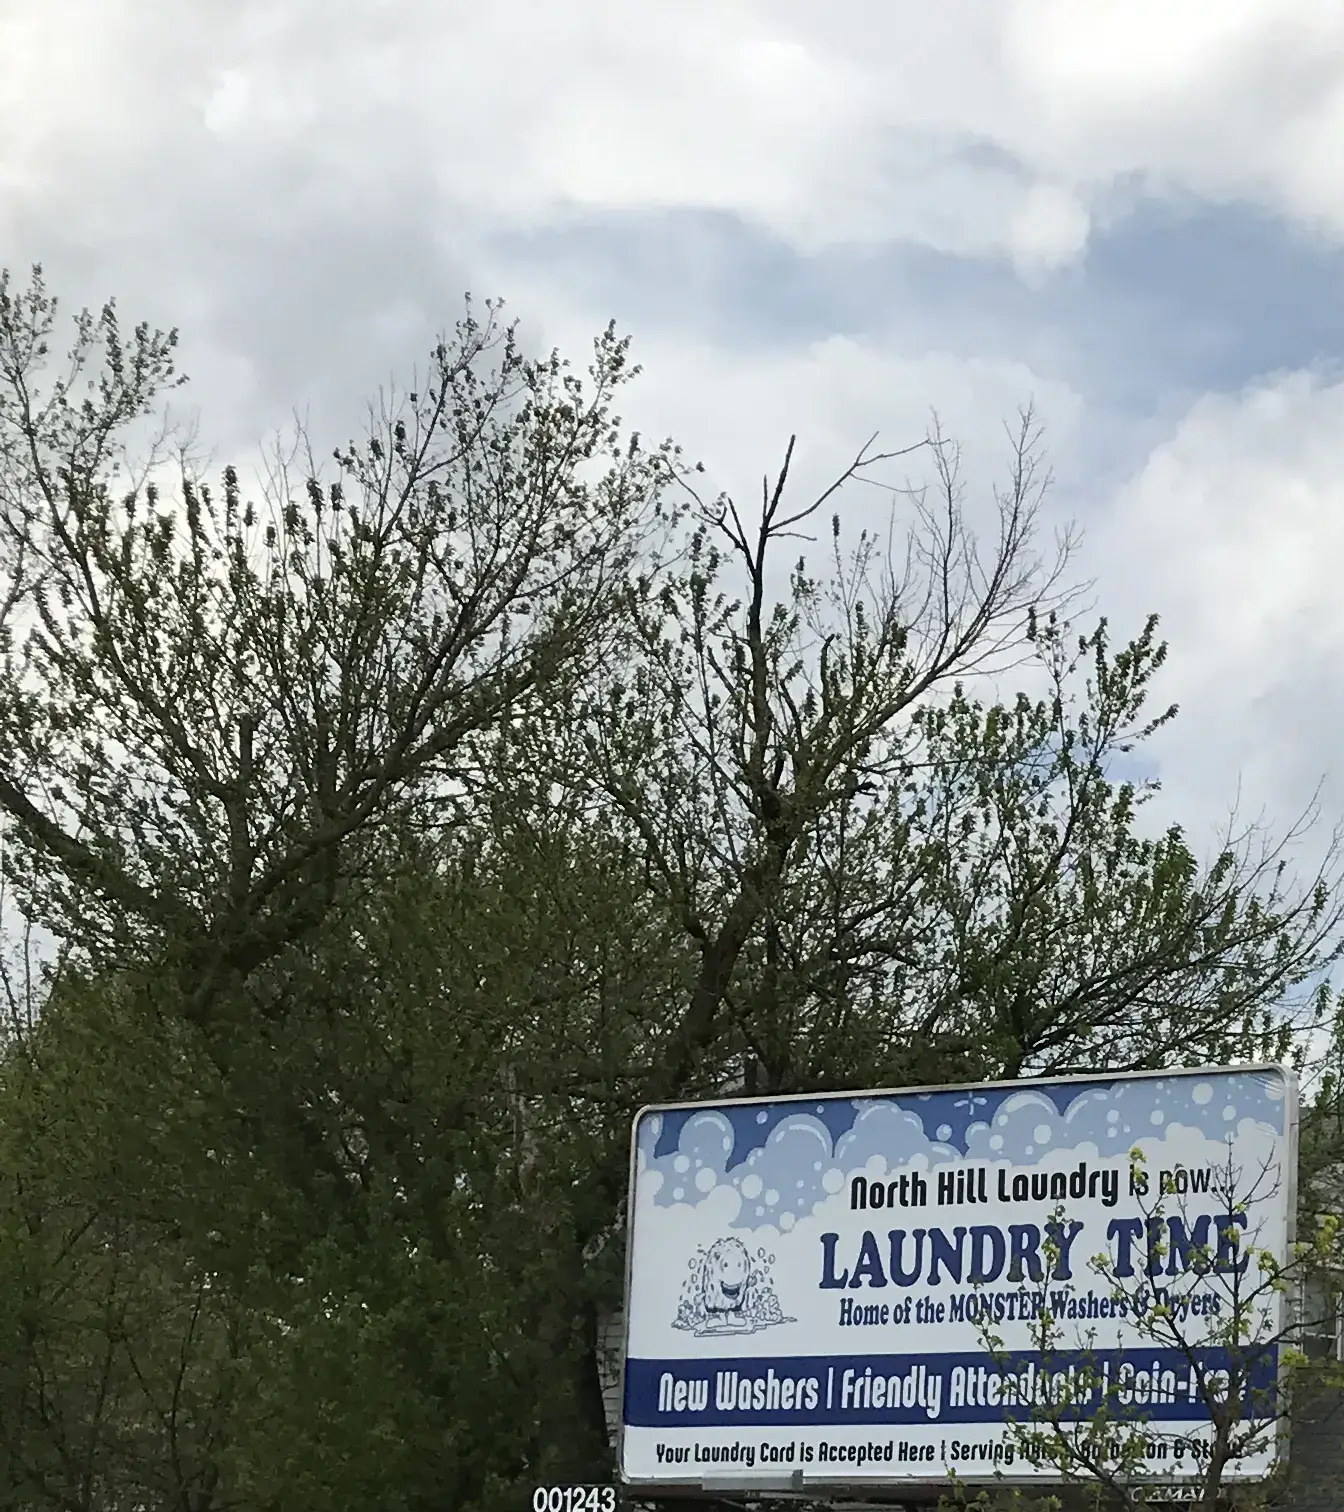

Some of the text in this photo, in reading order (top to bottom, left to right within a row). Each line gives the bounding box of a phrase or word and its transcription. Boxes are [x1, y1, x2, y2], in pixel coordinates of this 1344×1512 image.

[851, 1172, 927, 1210] North
[938, 1168, 988, 1206] Hill
[998, 1162, 1118, 1207] Laundry
[1129, 1165, 1149, 1196] is
[819, 1213, 1250, 1289] LAUNDRY TIME
[839, 1298, 889, 1326] Home
[893, 1296, 912, 1324] of
[916, 1296, 945, 1324] the
[949, 1291, 1044, 1322] MONSTER
[1050, 1290, 1128, 1320] Washers
[1155, 1287, 1220, 1322] Dryers
[658, 1372, 708, 1412] New
[715, 1368, 819, 1411] Washers
[841, 1365, 942, 1419] Friendly
[656, 1443, 690, 1463] Your
[694, 1441, 755, 1466] Laundry
[760, 1441, 795, 1463] Card
[800, 1441, 813, 1462] is
[818, 1440, 892, 1466] Accepted
[898, 1440, 935, 1462] Here
[950, 1439, 1015, 1466] Serving
[1173, 1438, 1186, 1459] &
